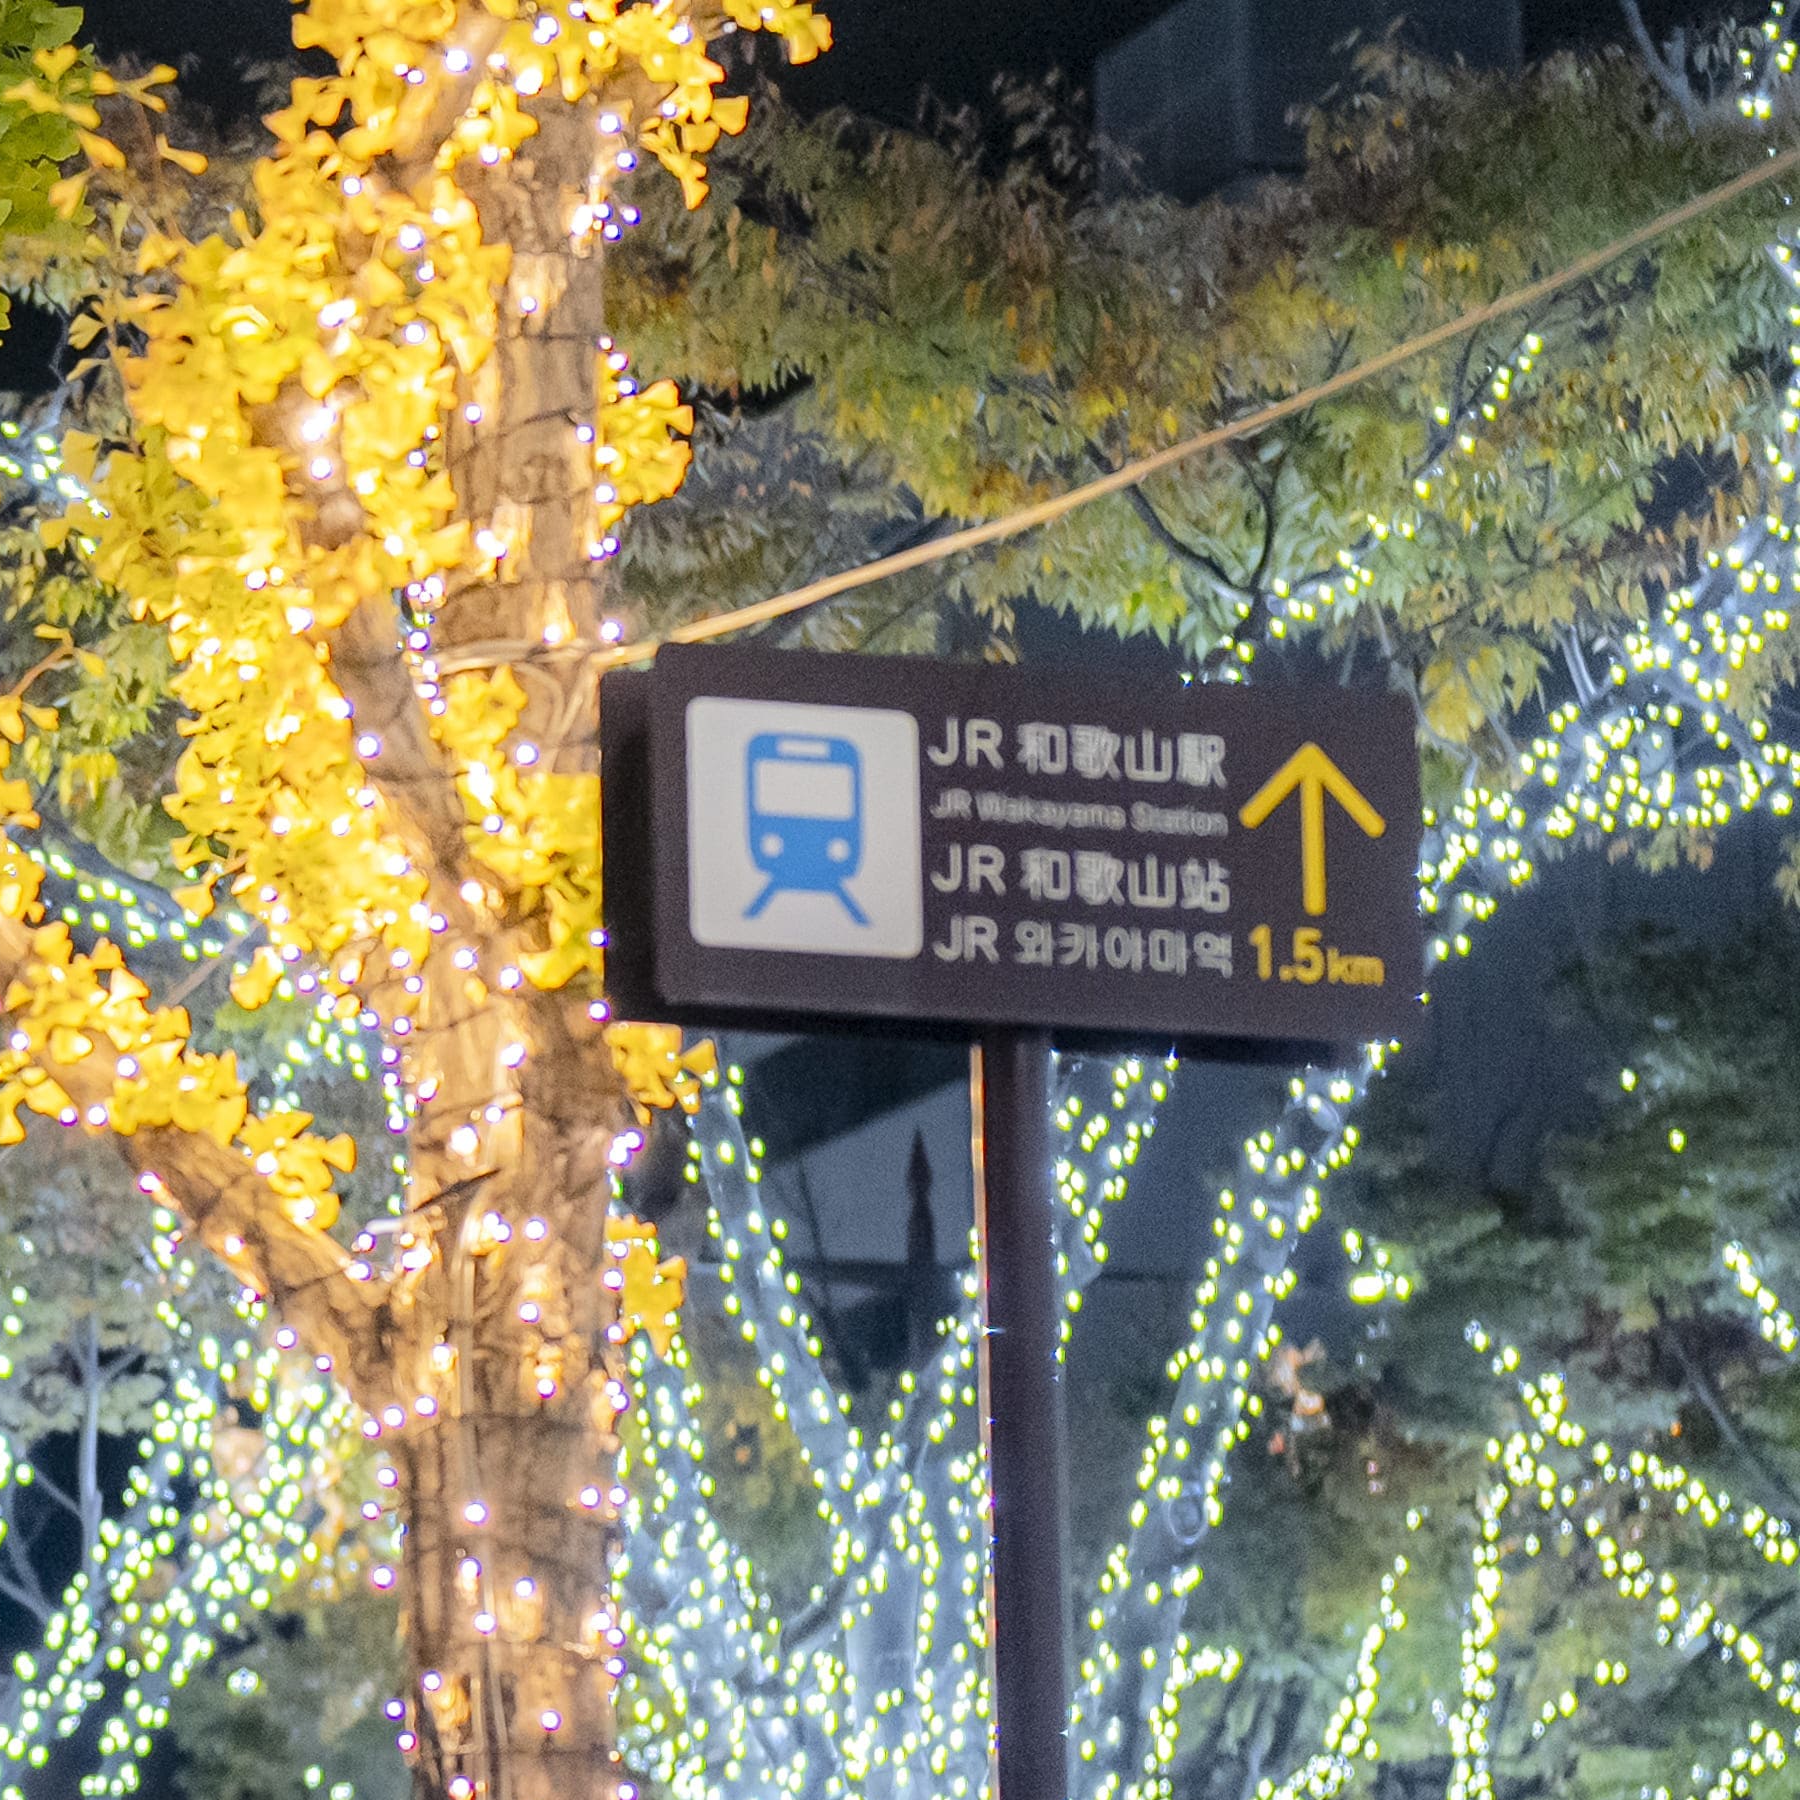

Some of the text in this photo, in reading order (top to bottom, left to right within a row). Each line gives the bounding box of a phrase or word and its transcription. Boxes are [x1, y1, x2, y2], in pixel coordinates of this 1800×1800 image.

[927, 717, 1228, 788] JR 和歌山駅
[929, 787, 1229, 837] JR Wakayama Station
[930, 843, 1232, 914] JR 和歌山站
[933, 914, 1000, 964] JR
[1248, 922, 1386, 986] 1.5km
